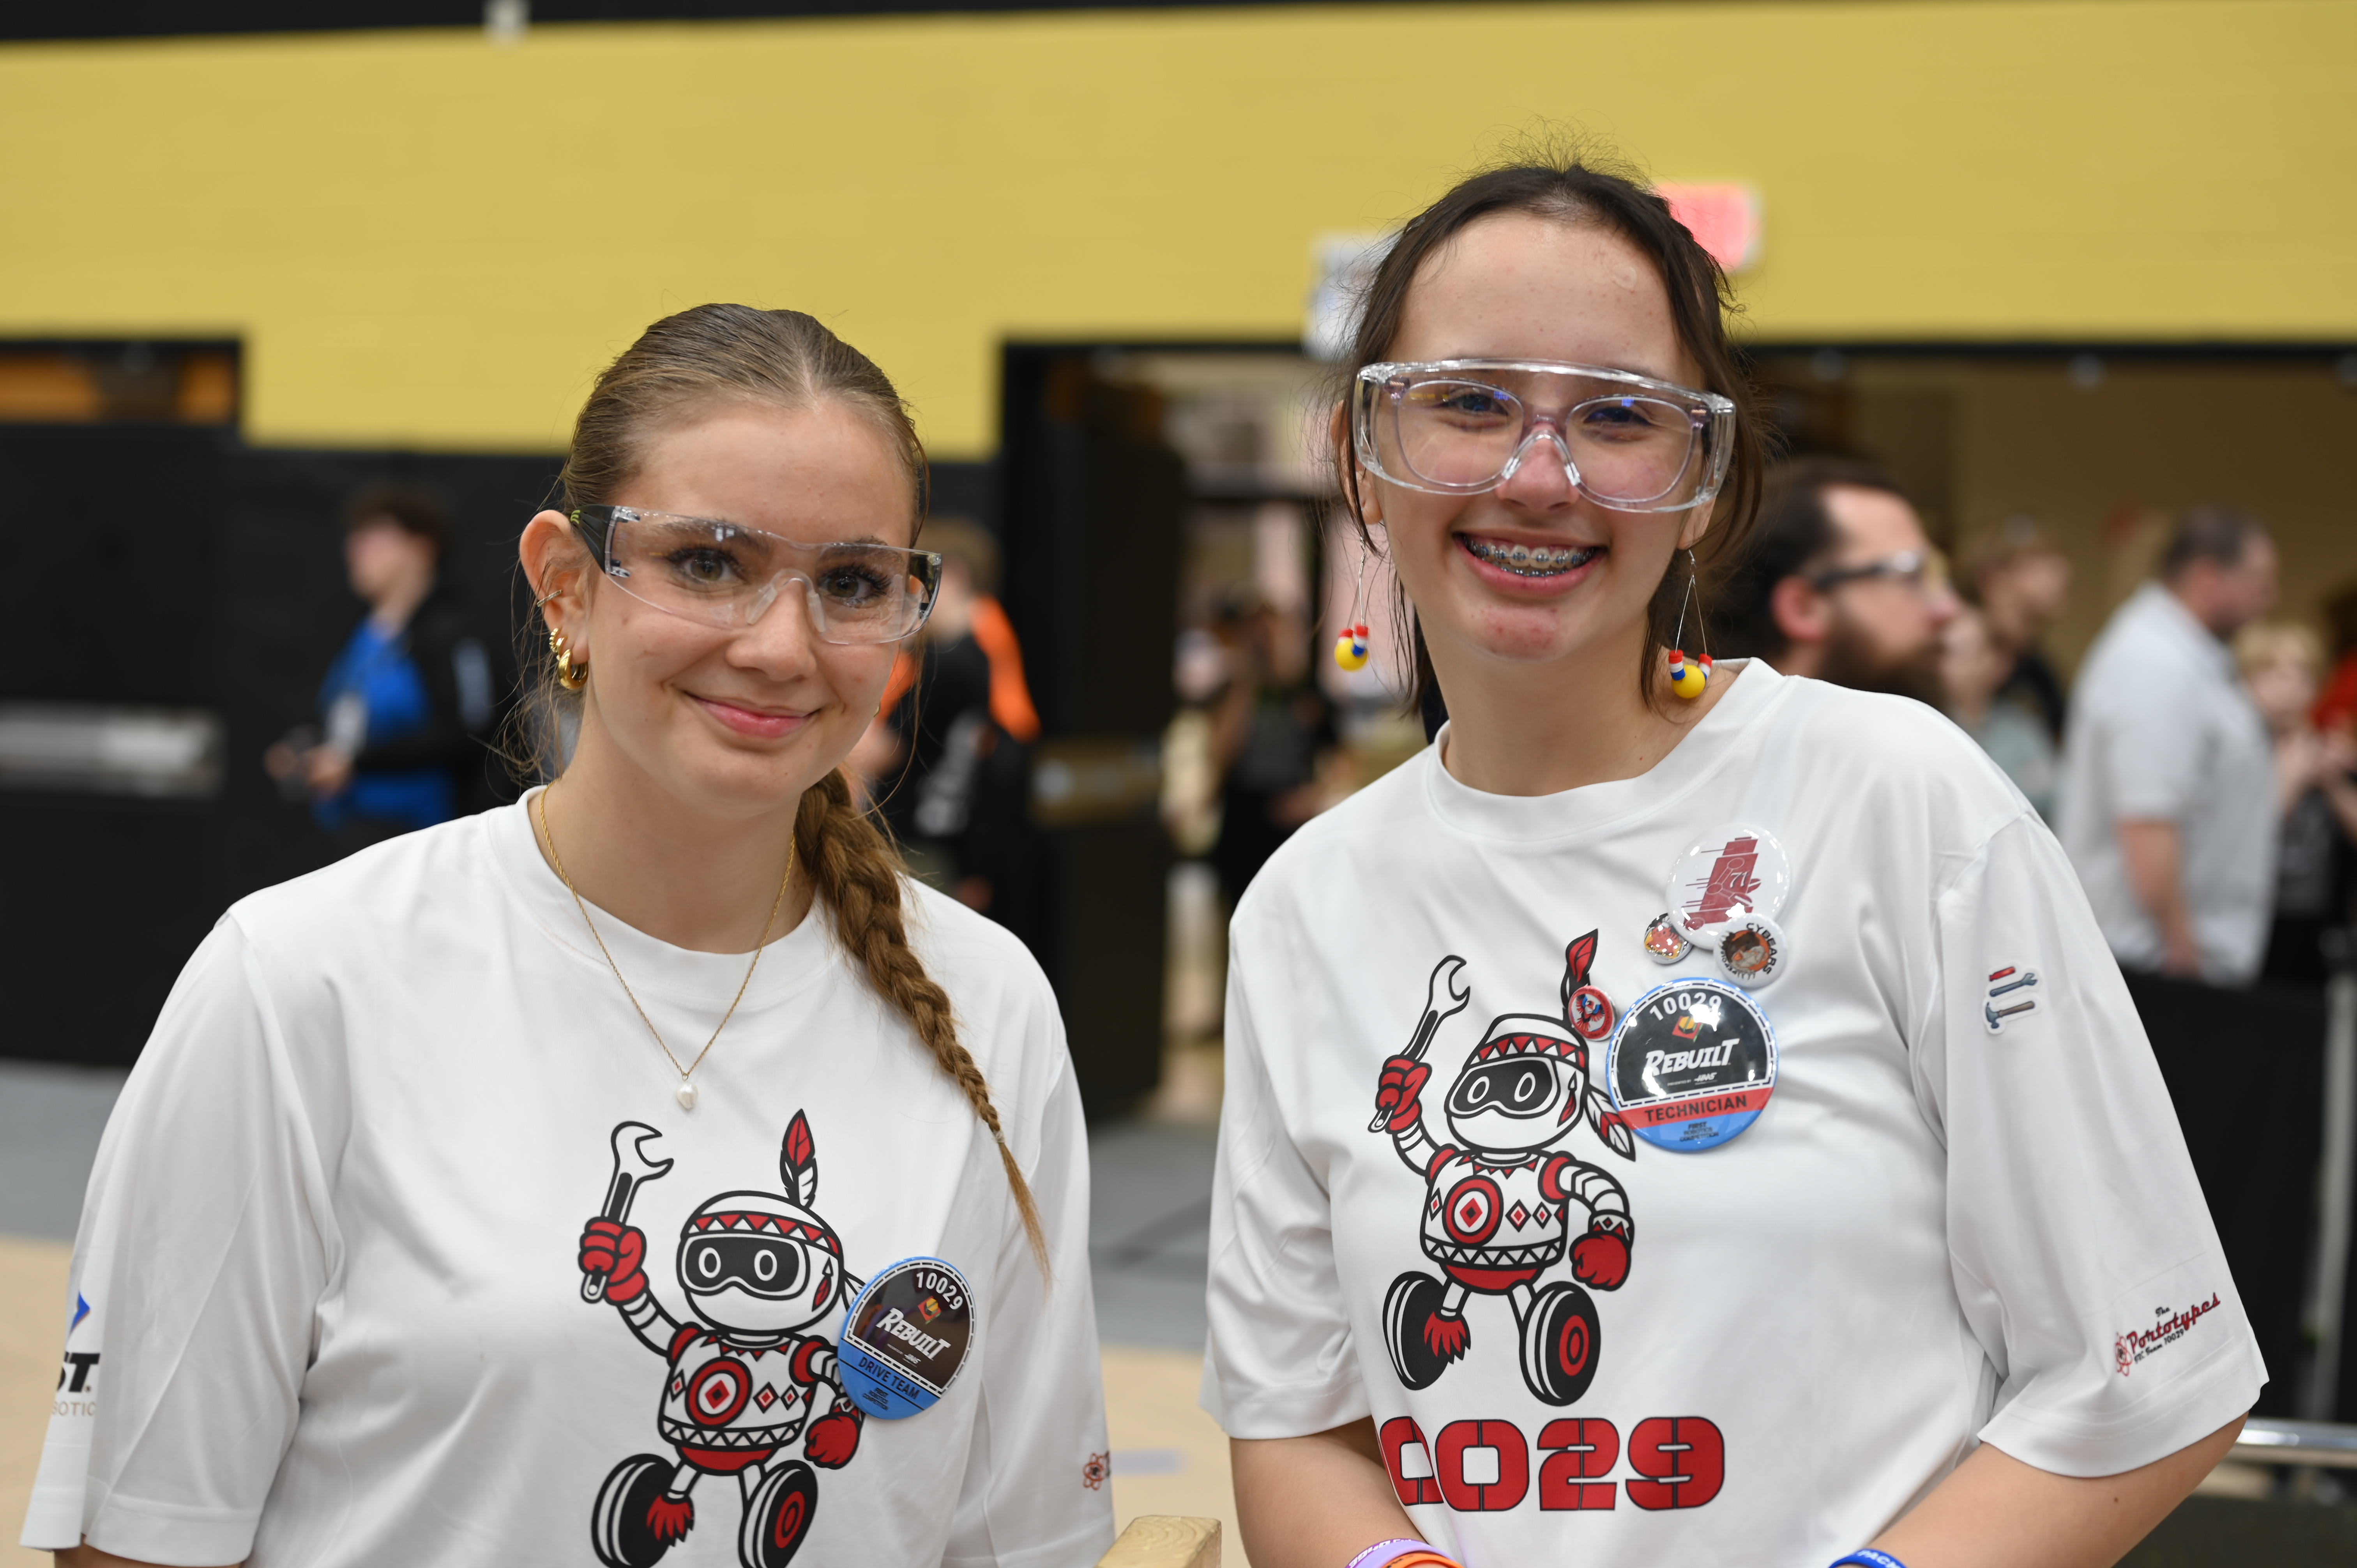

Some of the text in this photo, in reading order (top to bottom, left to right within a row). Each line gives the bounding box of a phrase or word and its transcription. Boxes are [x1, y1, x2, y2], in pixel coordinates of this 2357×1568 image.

[1730, 871, 1748, 888] 71
[1746, 923, 1777, 974] CYBEARS
[1650, 992, 1721, 1021] 10029
[1645, 1038, 1740, 1077] REBUILT
[1645, 1095, 1747, 1122] TECHNICIAN
[916, 1271, 963, 1310] 10029
[2126, 1292, 2221, 1354] Portotypes
[2156, 1307, 2171, 1317] The
[876, 1307, 951, 1360] REBUILT
[2164, 1328, 2184, 1345] 10029
[858, 1356, 891, 1383] DRIVE
[891, 1376, 920, 1400] TEAM
[1375, 1416, 1725, 1512] 0029
